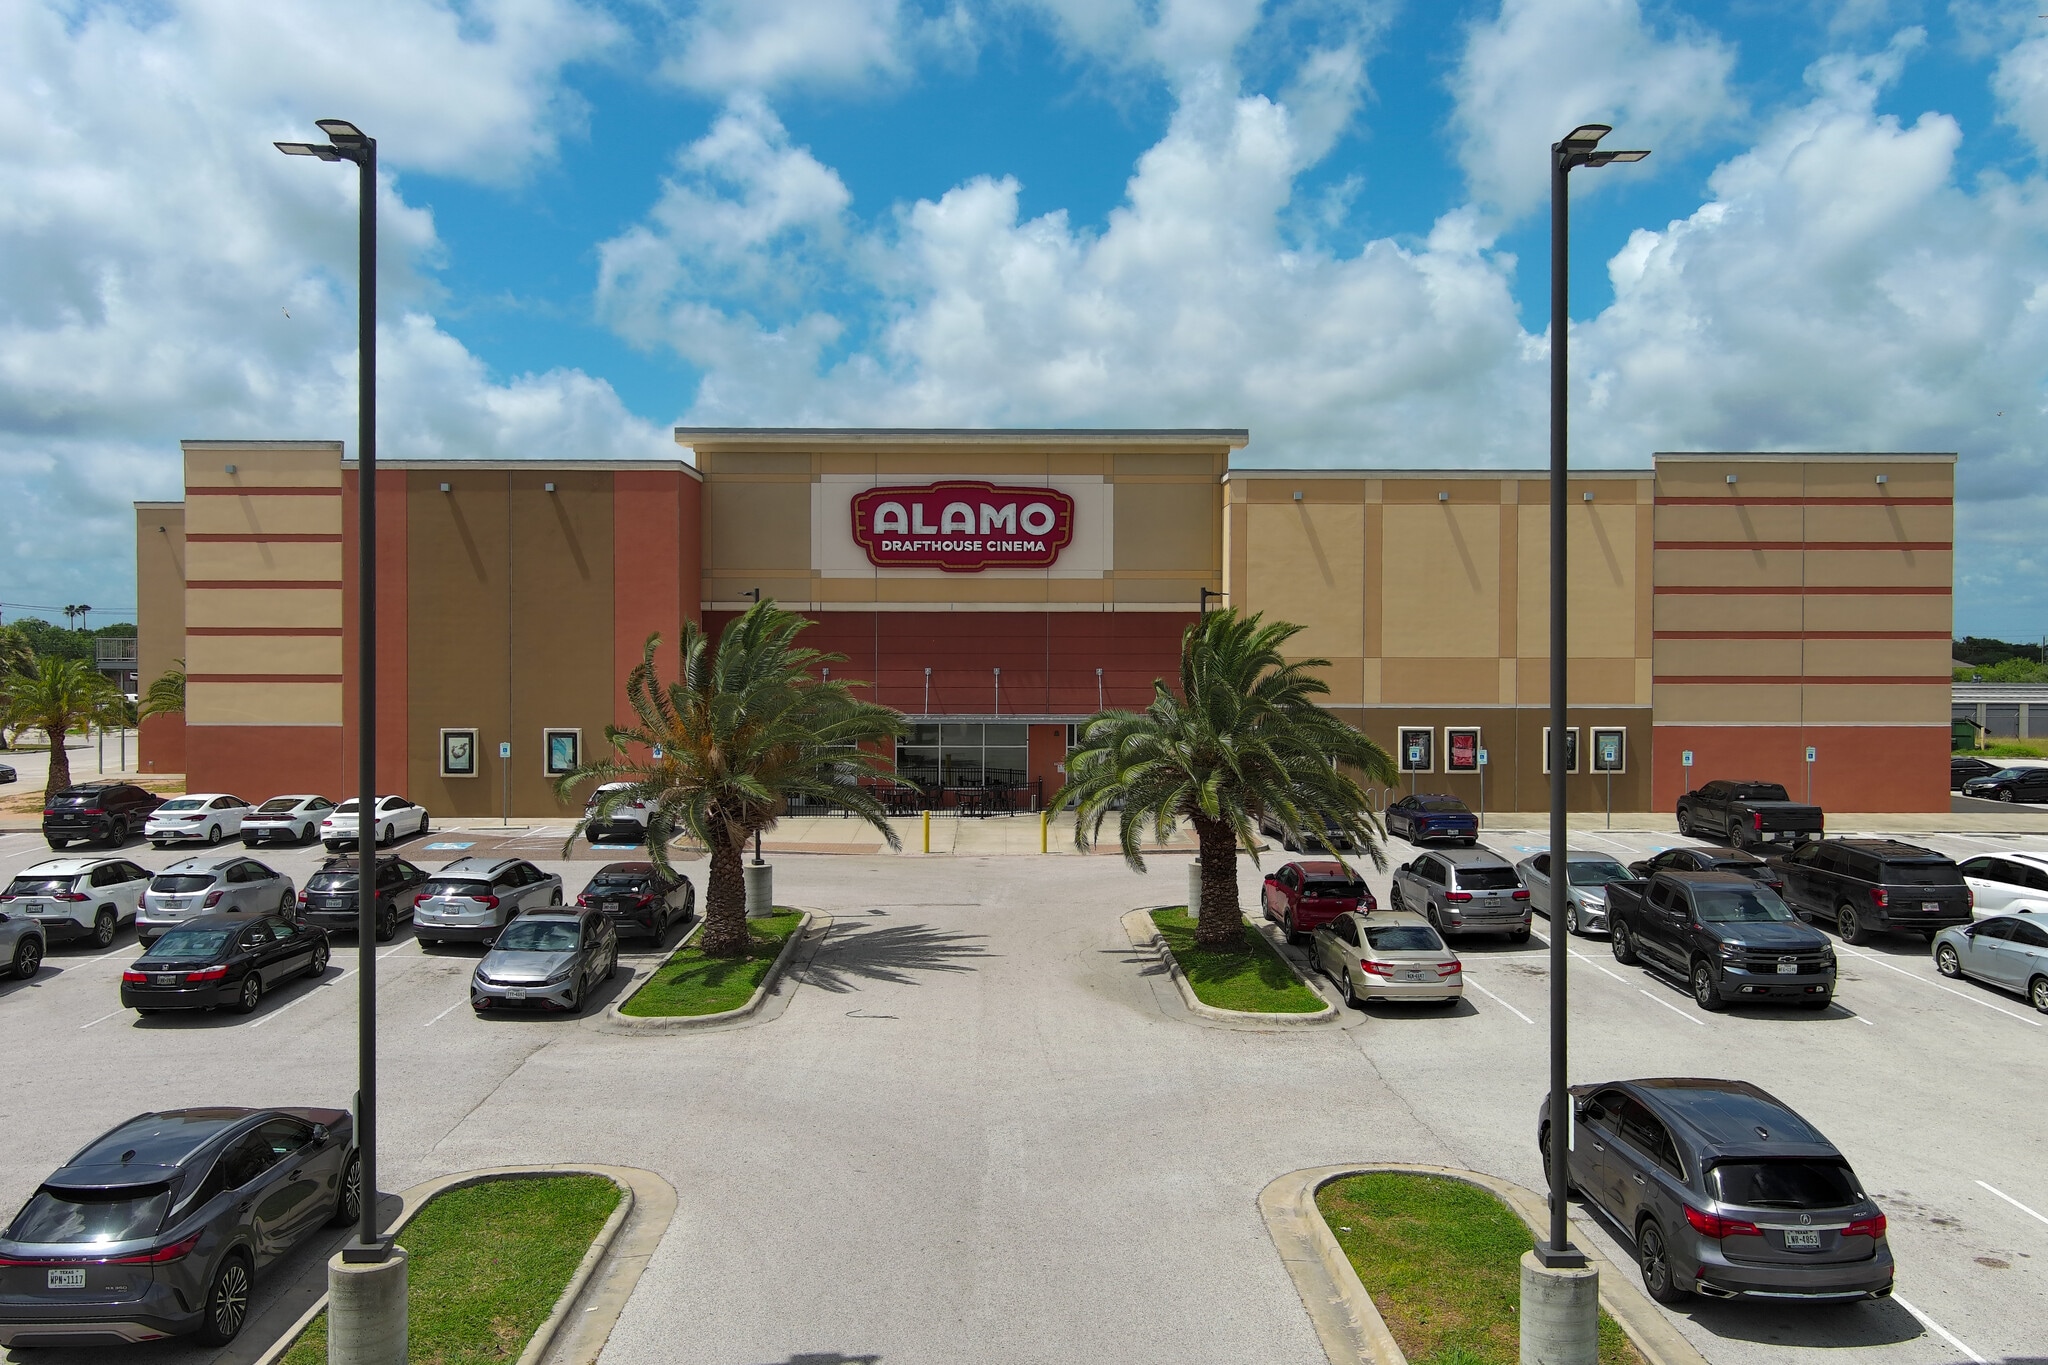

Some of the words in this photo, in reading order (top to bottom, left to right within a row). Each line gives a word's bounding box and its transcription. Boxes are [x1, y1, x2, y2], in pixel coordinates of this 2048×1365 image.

[873, 501, 1056, 536] ALAMO
[881, 540, 982, 552] DRAFTHOUSE
[986, 540, 1046, 552] CINEMA
